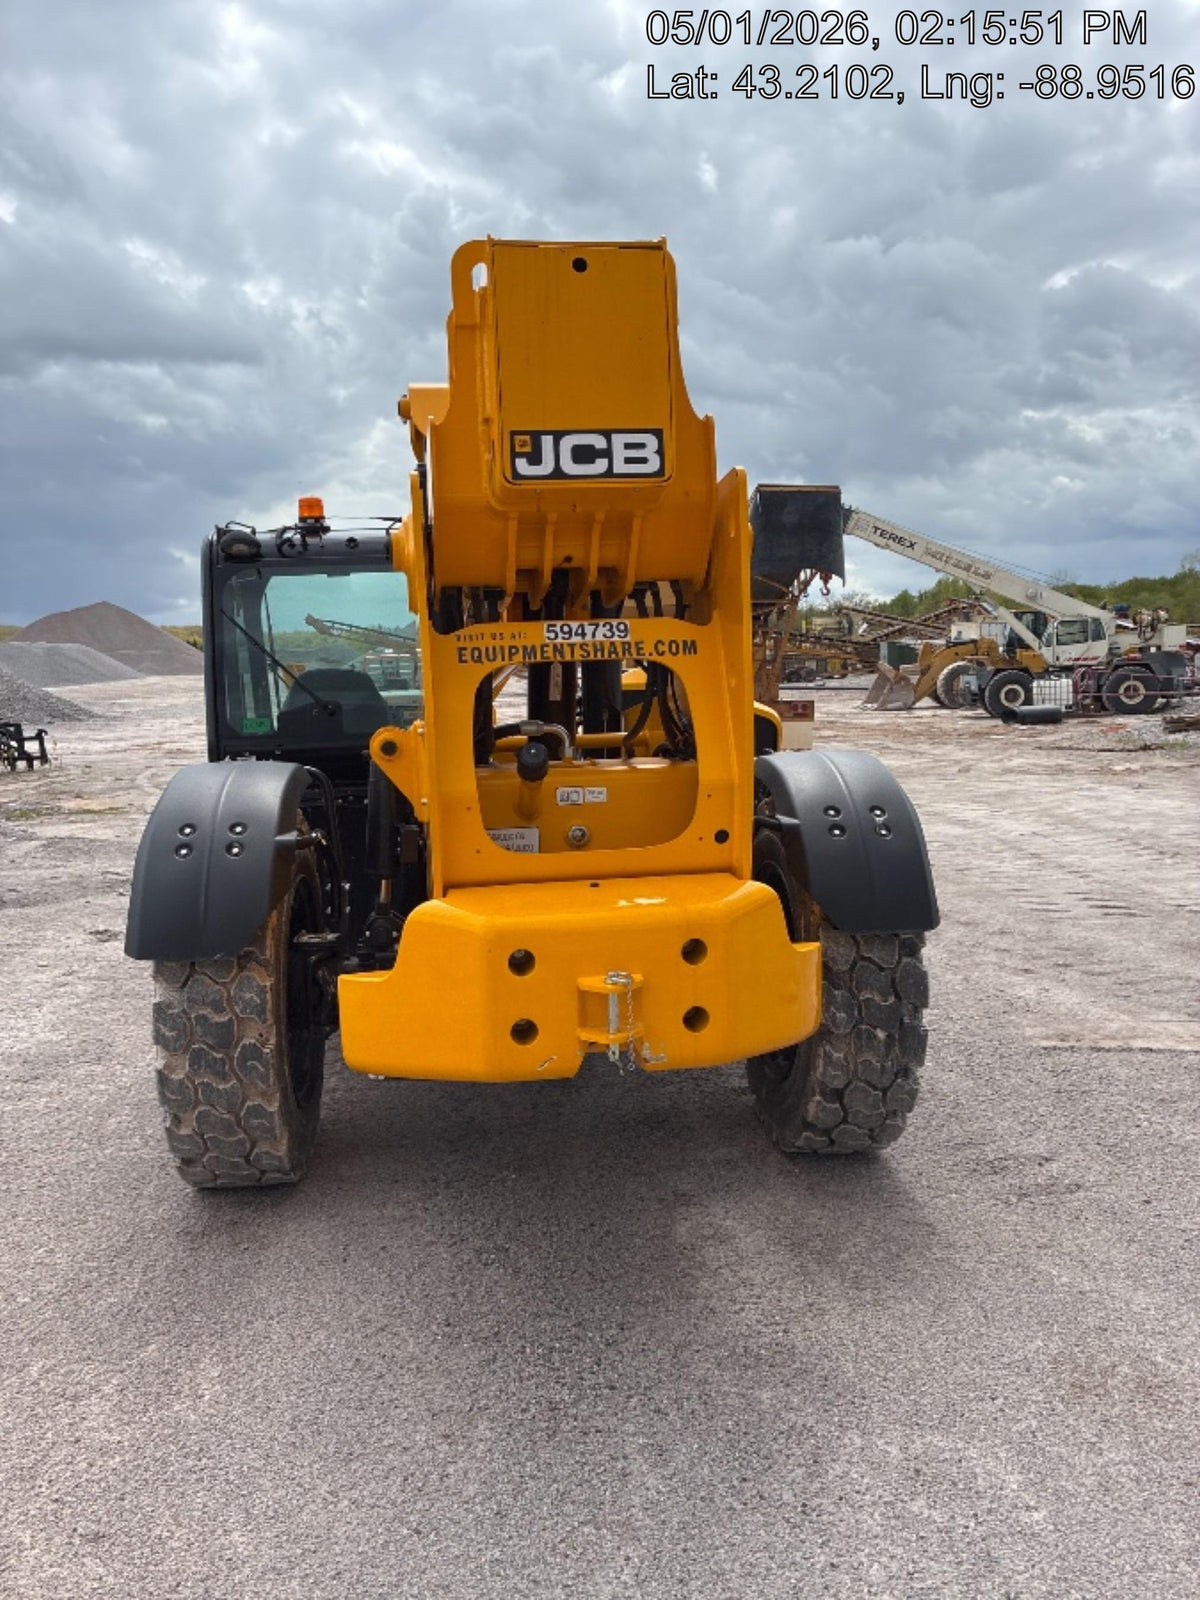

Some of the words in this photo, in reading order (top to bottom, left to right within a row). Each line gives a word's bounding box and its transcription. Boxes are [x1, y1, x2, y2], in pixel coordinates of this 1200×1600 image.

[514, 433, 661, 476] JCB
[871, 525, 919, 551] TEREX
[490, 632, 505, 641] US
[545, 621, 630, 642] 594739
[456, 639, 699, 665] EQUIPMENTSHARE.COM
